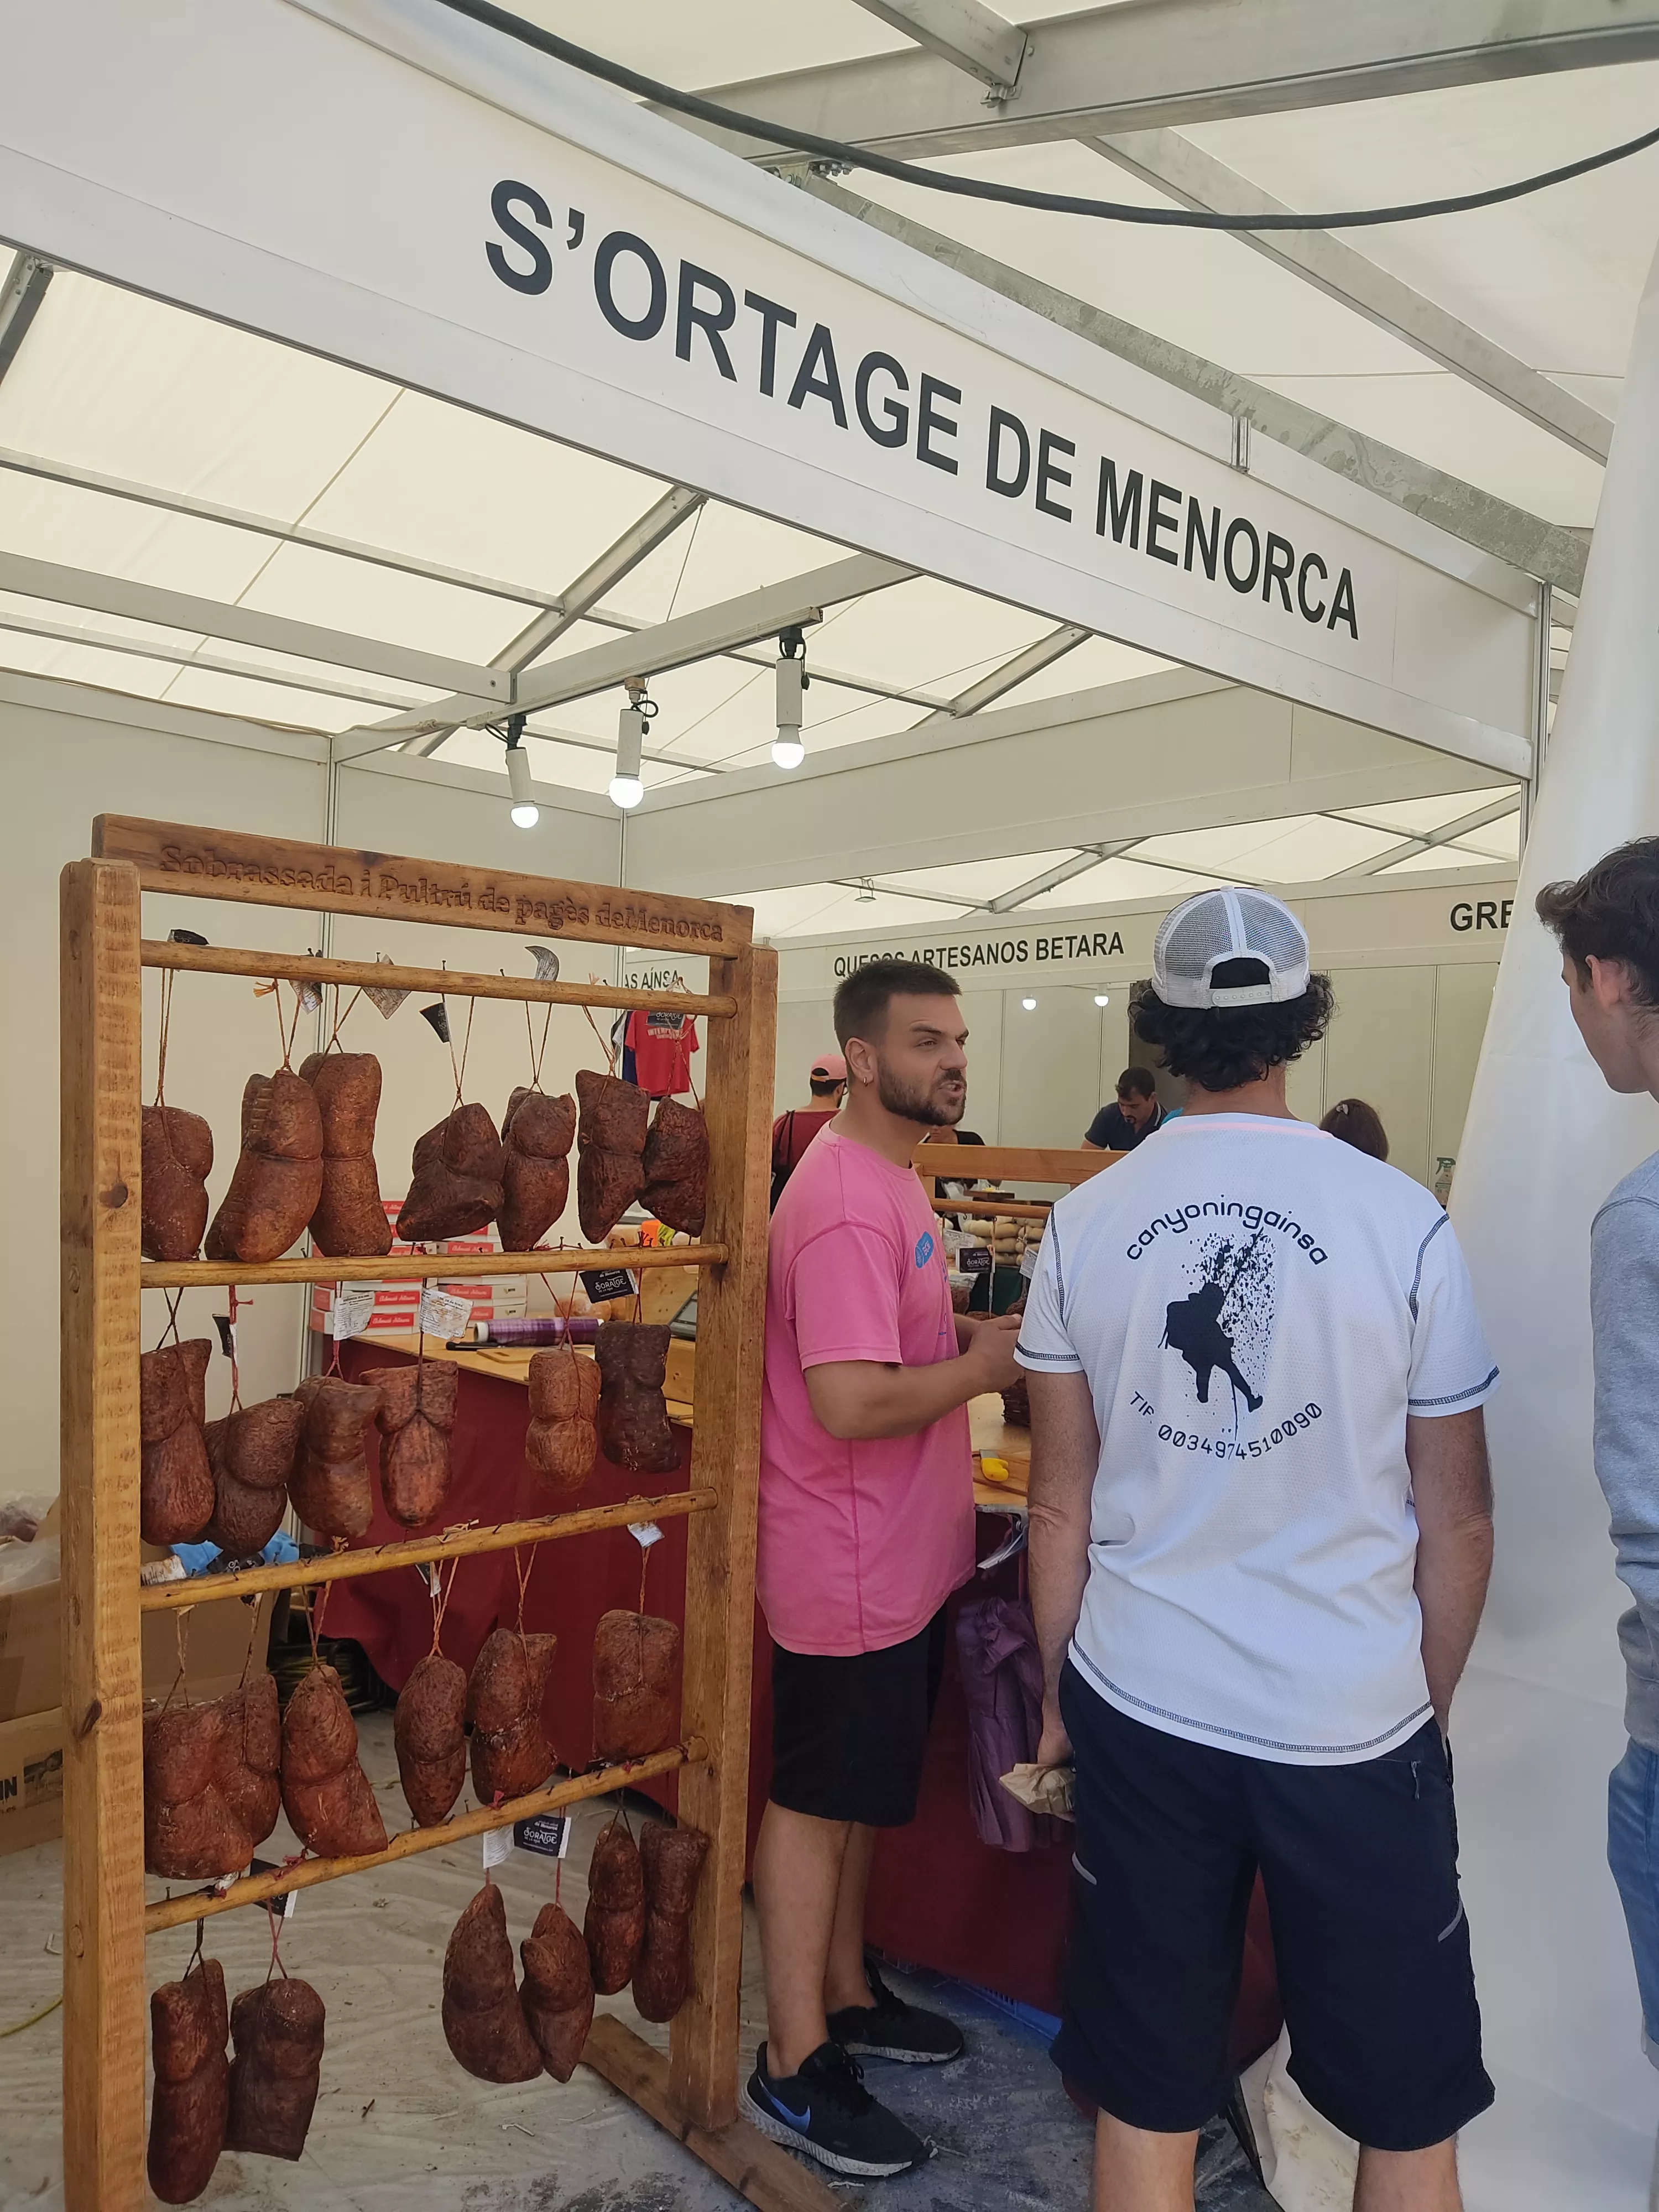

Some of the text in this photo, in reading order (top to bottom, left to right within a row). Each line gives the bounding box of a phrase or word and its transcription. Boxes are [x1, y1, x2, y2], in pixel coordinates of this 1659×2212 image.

[985, 405, 1076, 523] DE
[1096, 456, 1359, 640] MENORCA
[159, 846, 352, 895] Sobrassada
[361, 869, 372, 897] i
[478, 887, 510, 914] de
[515, 895, 590, 930] pagès
[912, 940, 1028, 969] ARTESANOS
[1036, 932, 1124, 961] BETARA
[1126, 1194, 1328, 1265] canyoningainsa
[1158, 1402, 1322, 1460] 0034974510090
